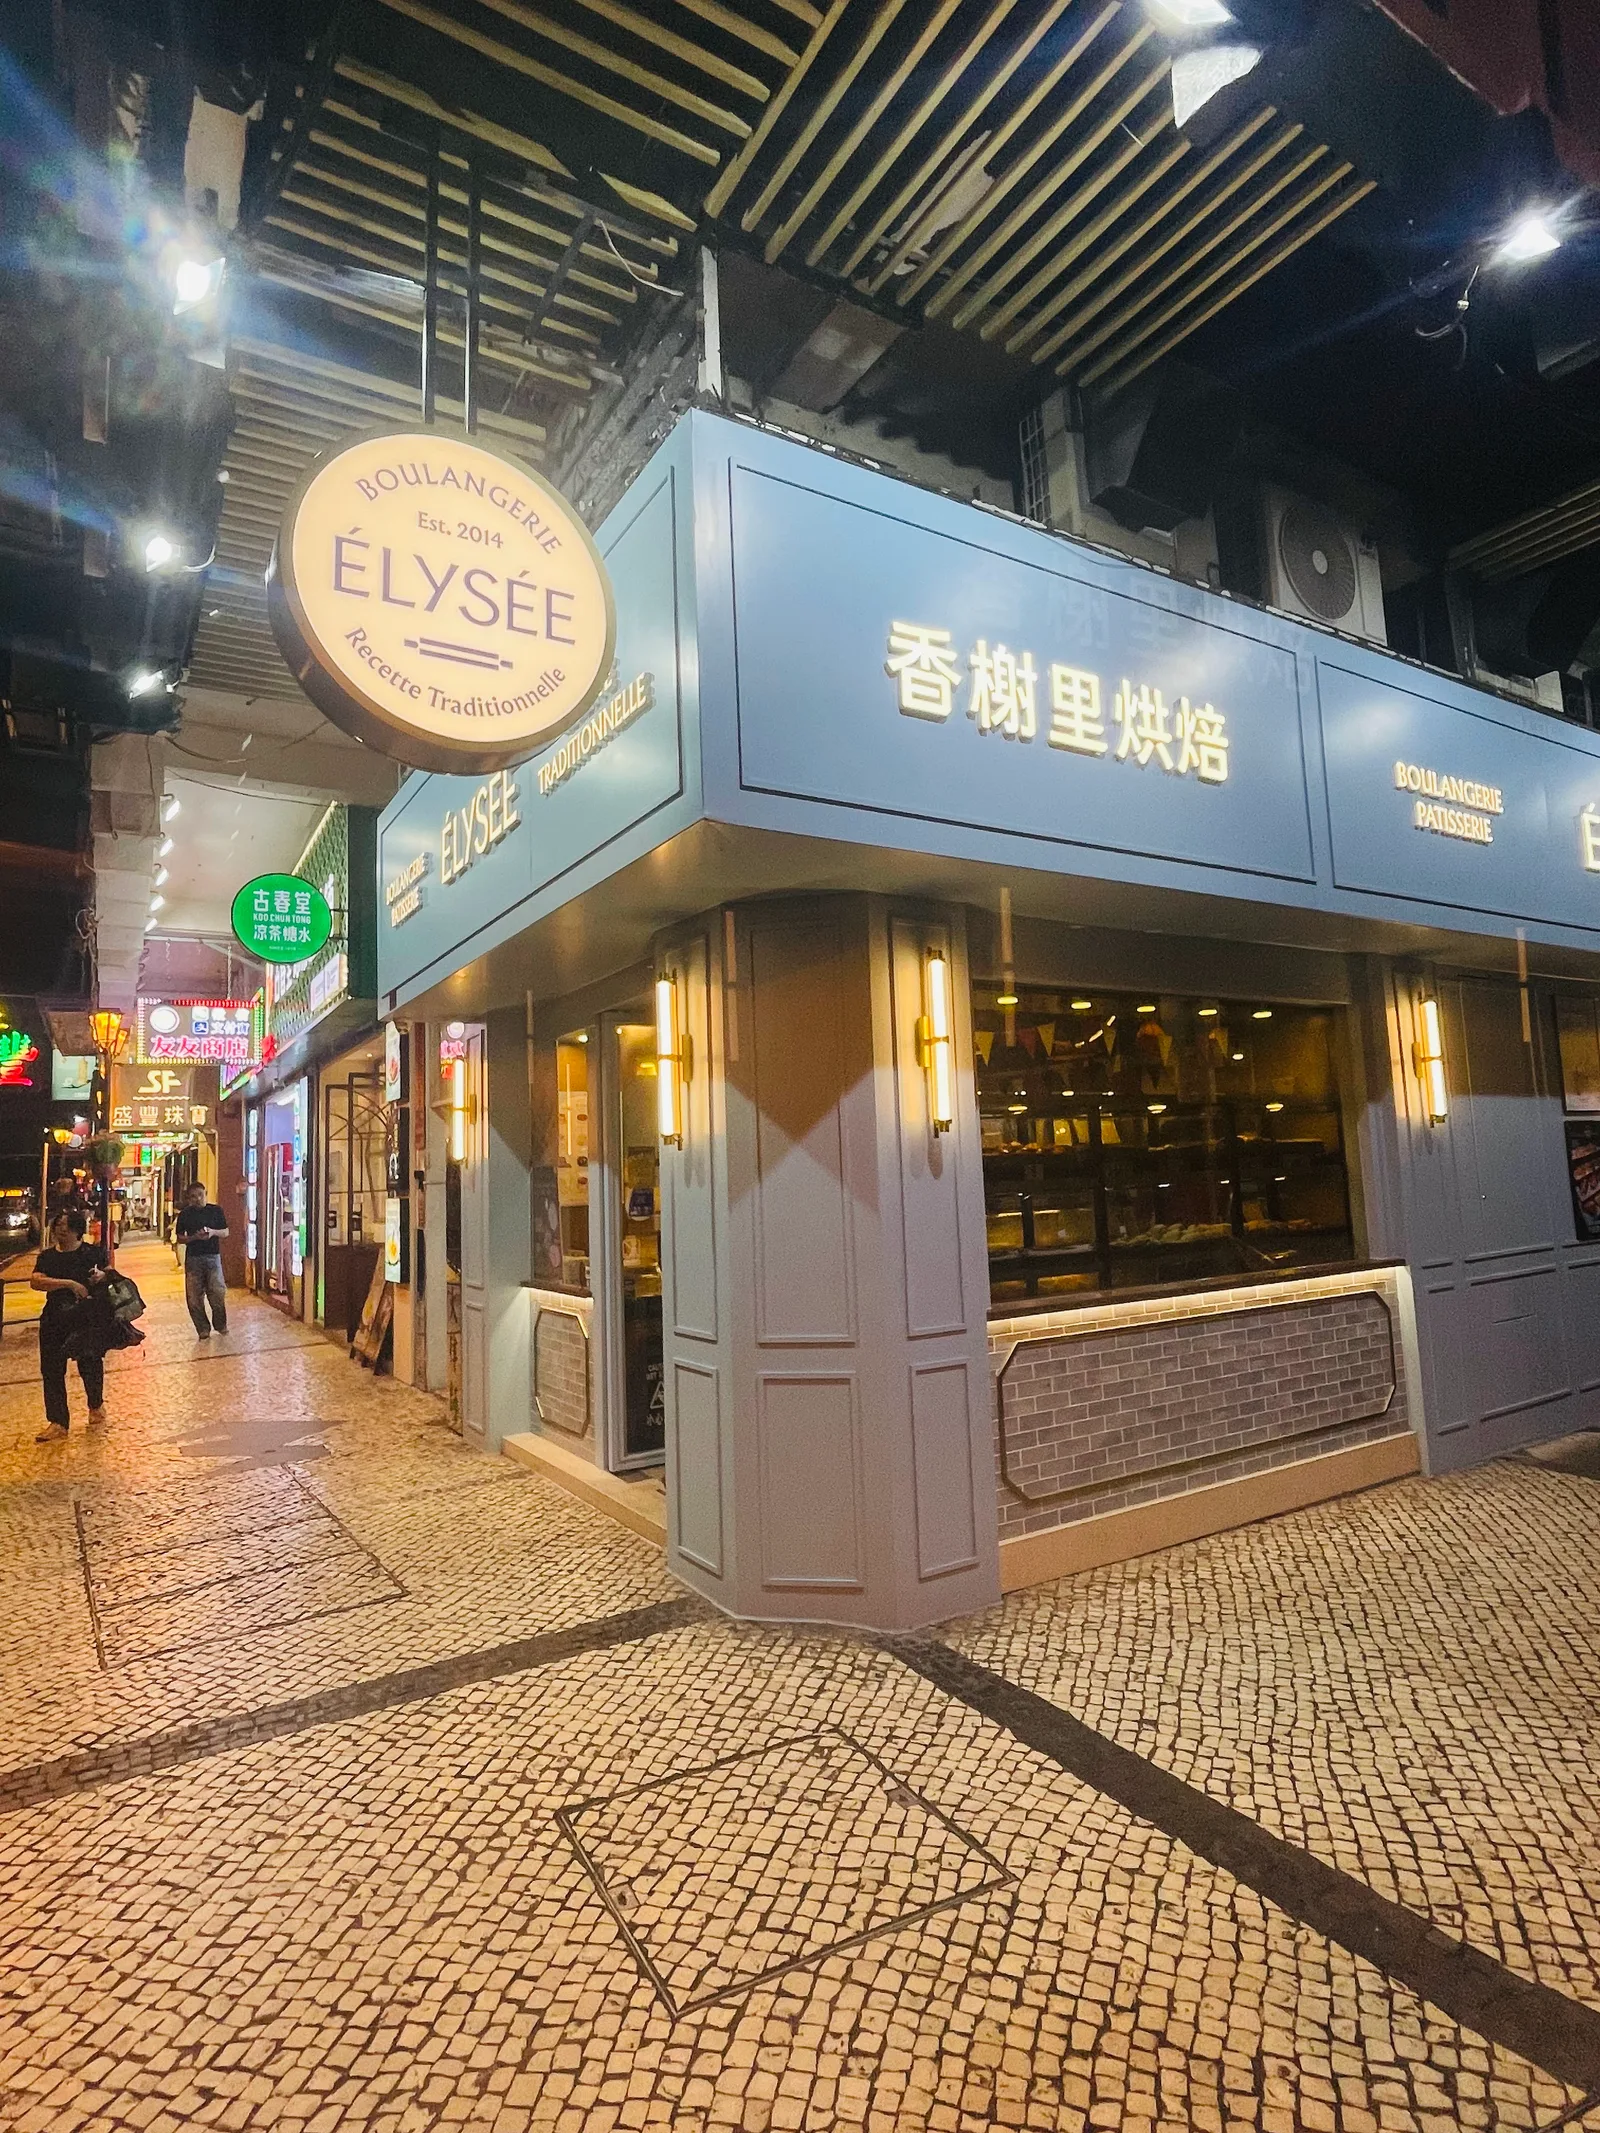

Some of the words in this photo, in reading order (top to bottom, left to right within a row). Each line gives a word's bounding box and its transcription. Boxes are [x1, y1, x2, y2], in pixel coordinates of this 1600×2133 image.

[355, 463, 562, 554] BOULANGERIE
[418, 511, 451, 536] Est.
[457, 522, 503, 549] 2014
[333, 526, 576, 645] ÉLYSÉE
[344, 627, 422, 700] Recette
[428, 667, 566, 718] Traditionnelle
[886, 621, 1230, 784] 香榭里烘焙
[537, 672, 648, 796] TRADITIONNELLE
[1394, 761, 1504, 815] BOULANGERIE
[1415, 801, 1494, 843] PATISSERIE
[253, 889, 311, 915] 古春堂
[253, 913, 269, 922] KOO
[270, 914, 291, 923] CHUN
[292, 915, 311, 925] TONG
[151, 1035, 249, 1059] 友友商店
[112, 1105, 209, 1127] 盛豐珠寶
